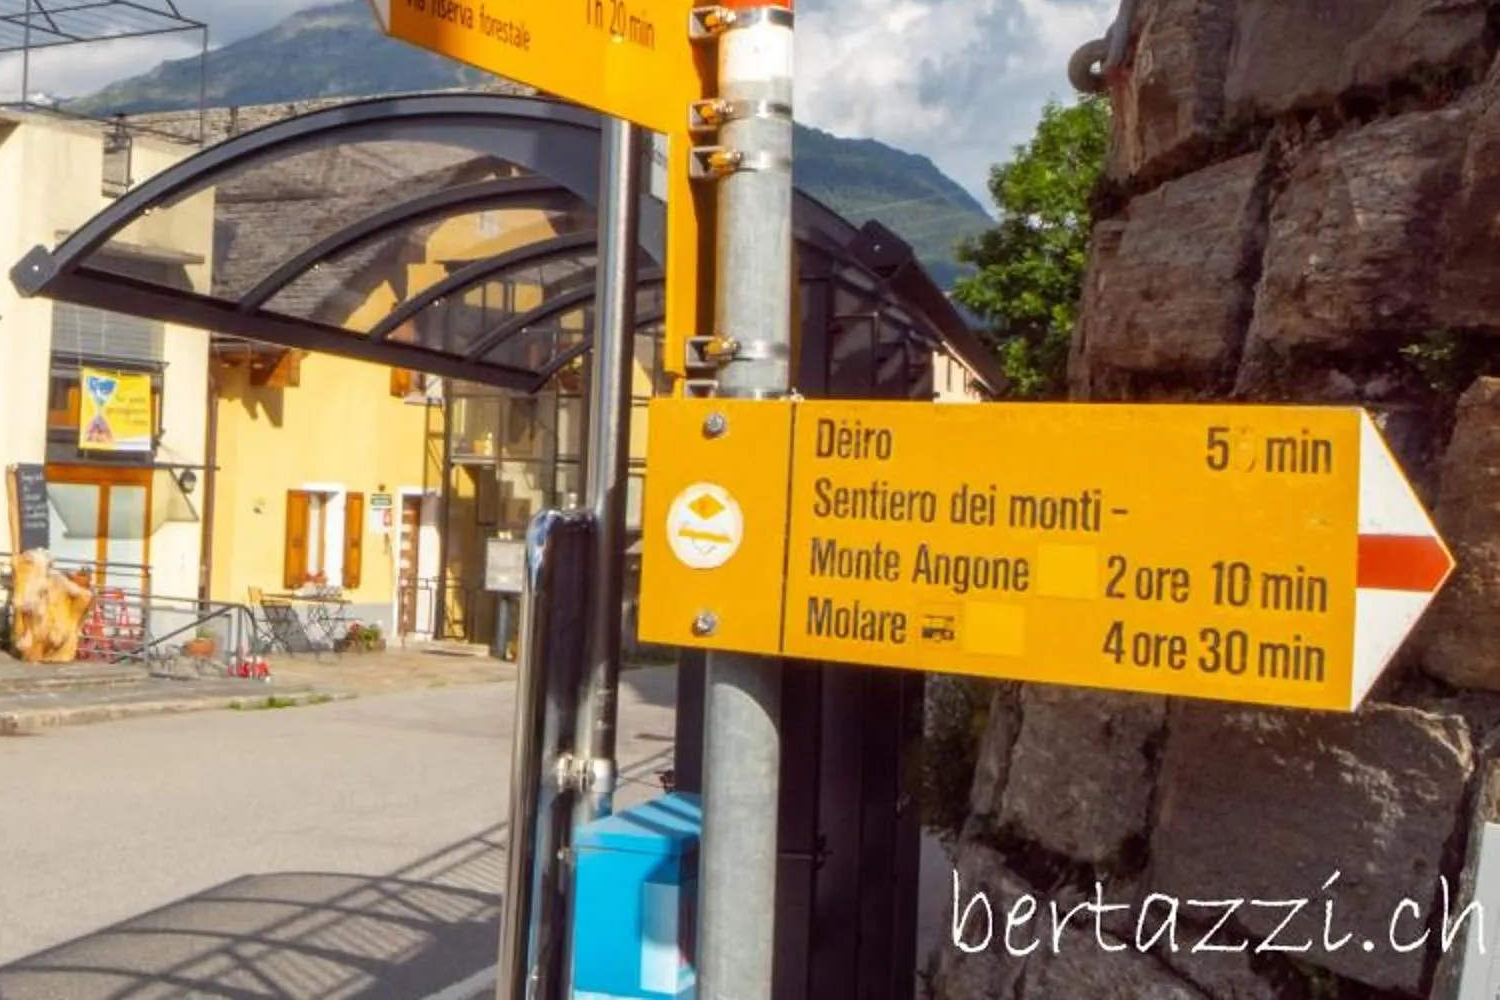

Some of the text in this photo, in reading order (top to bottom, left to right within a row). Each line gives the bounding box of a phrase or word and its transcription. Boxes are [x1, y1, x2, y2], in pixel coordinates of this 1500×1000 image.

[479, 3, 532, 52] forestale
[1265, 428, 1333, 474] min
[813, 477, 937, 523] Sentiero
[949, 484, 997, 527] dei
[1008, 489, 1102, 533] monti
[809, 537, 1328, 614] Monte Angone 2 ore 10 min
[806, 597, 1326, 683] Molare 4 ore 30 min
